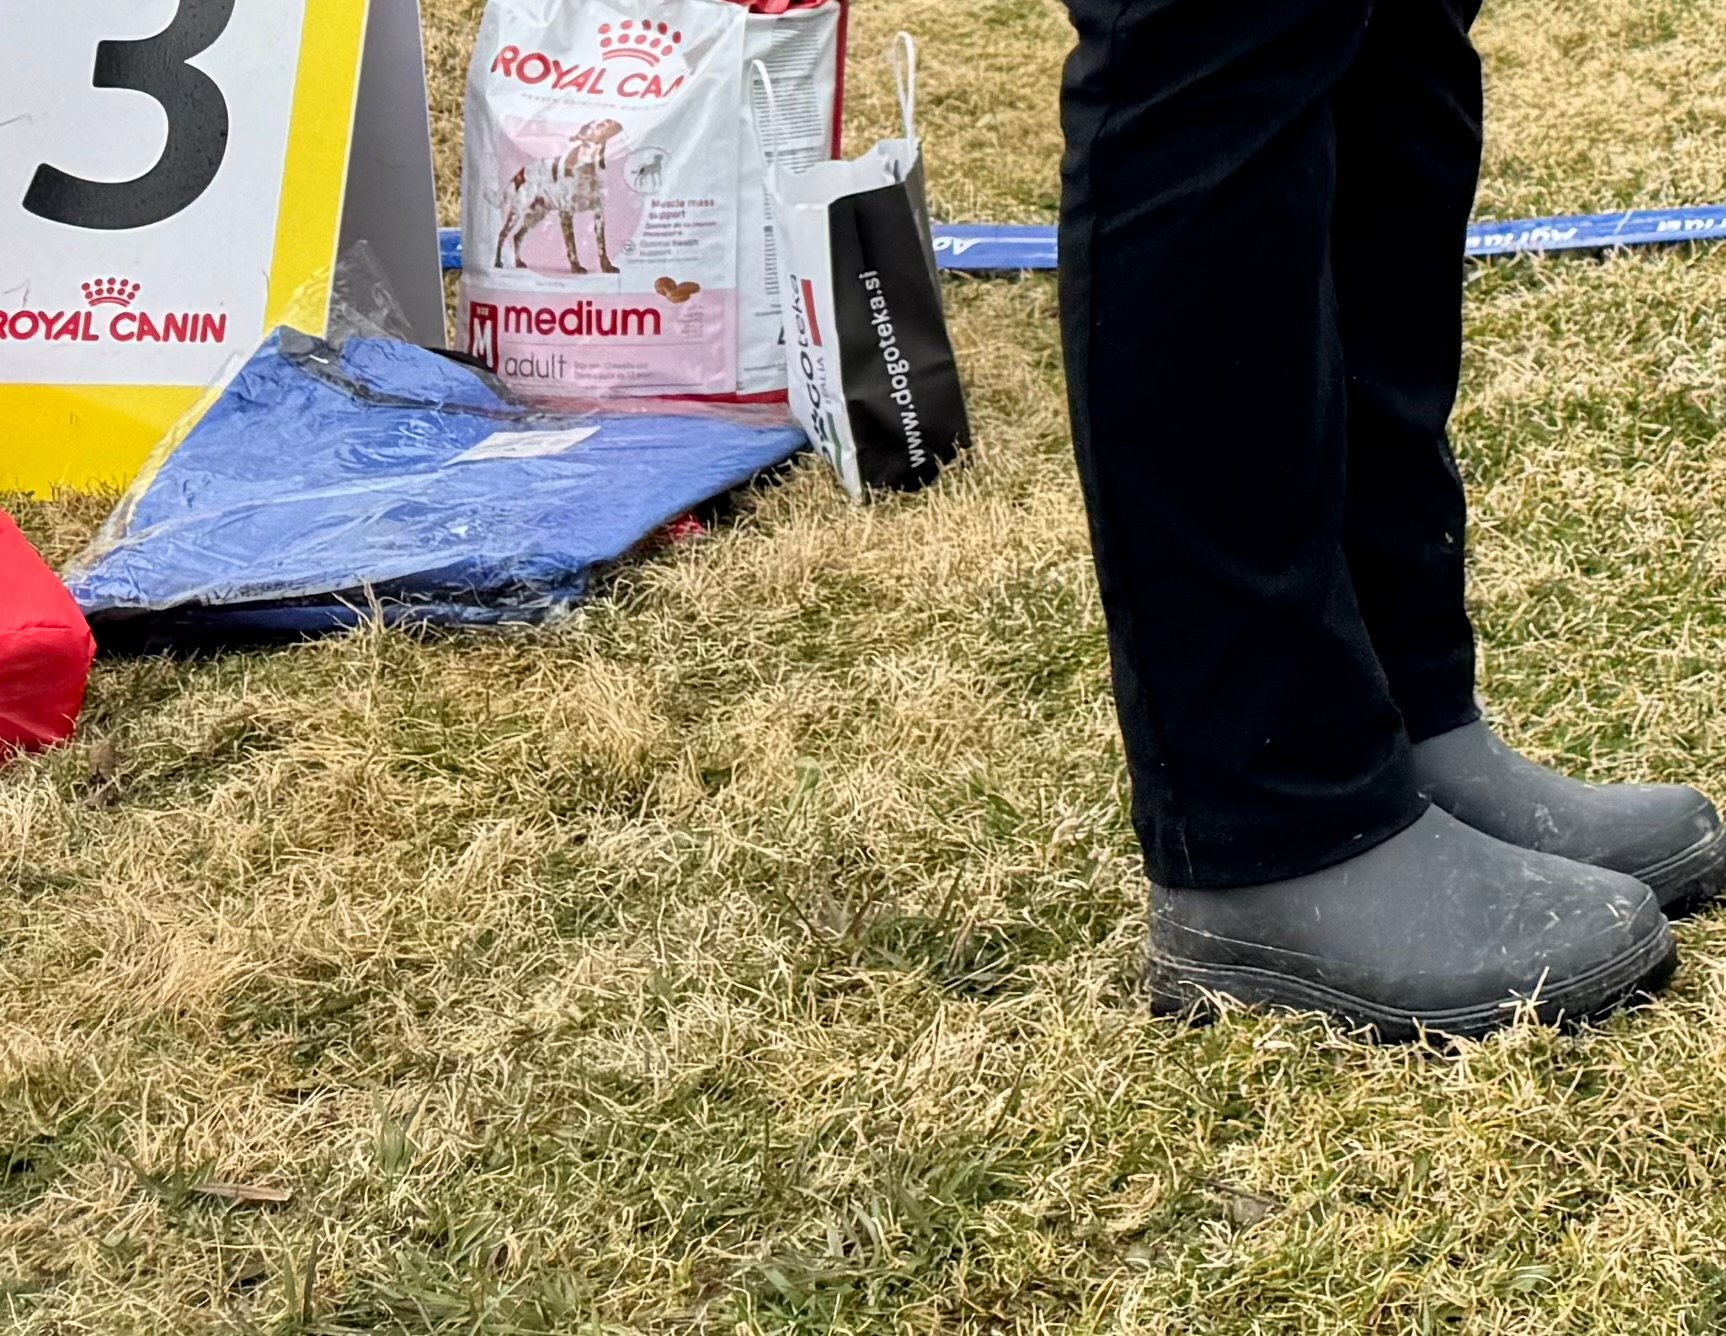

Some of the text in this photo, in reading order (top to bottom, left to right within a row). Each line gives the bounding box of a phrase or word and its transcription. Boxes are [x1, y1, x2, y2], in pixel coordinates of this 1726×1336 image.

[488, 44, 607, 95] ROYAL
[109, 311, 227, 343] CANIN
[503, 299, 662, 336] medium
[504, 353, 568, 379] adult
[857, 269, 927, 469] www.dogoteka.si
